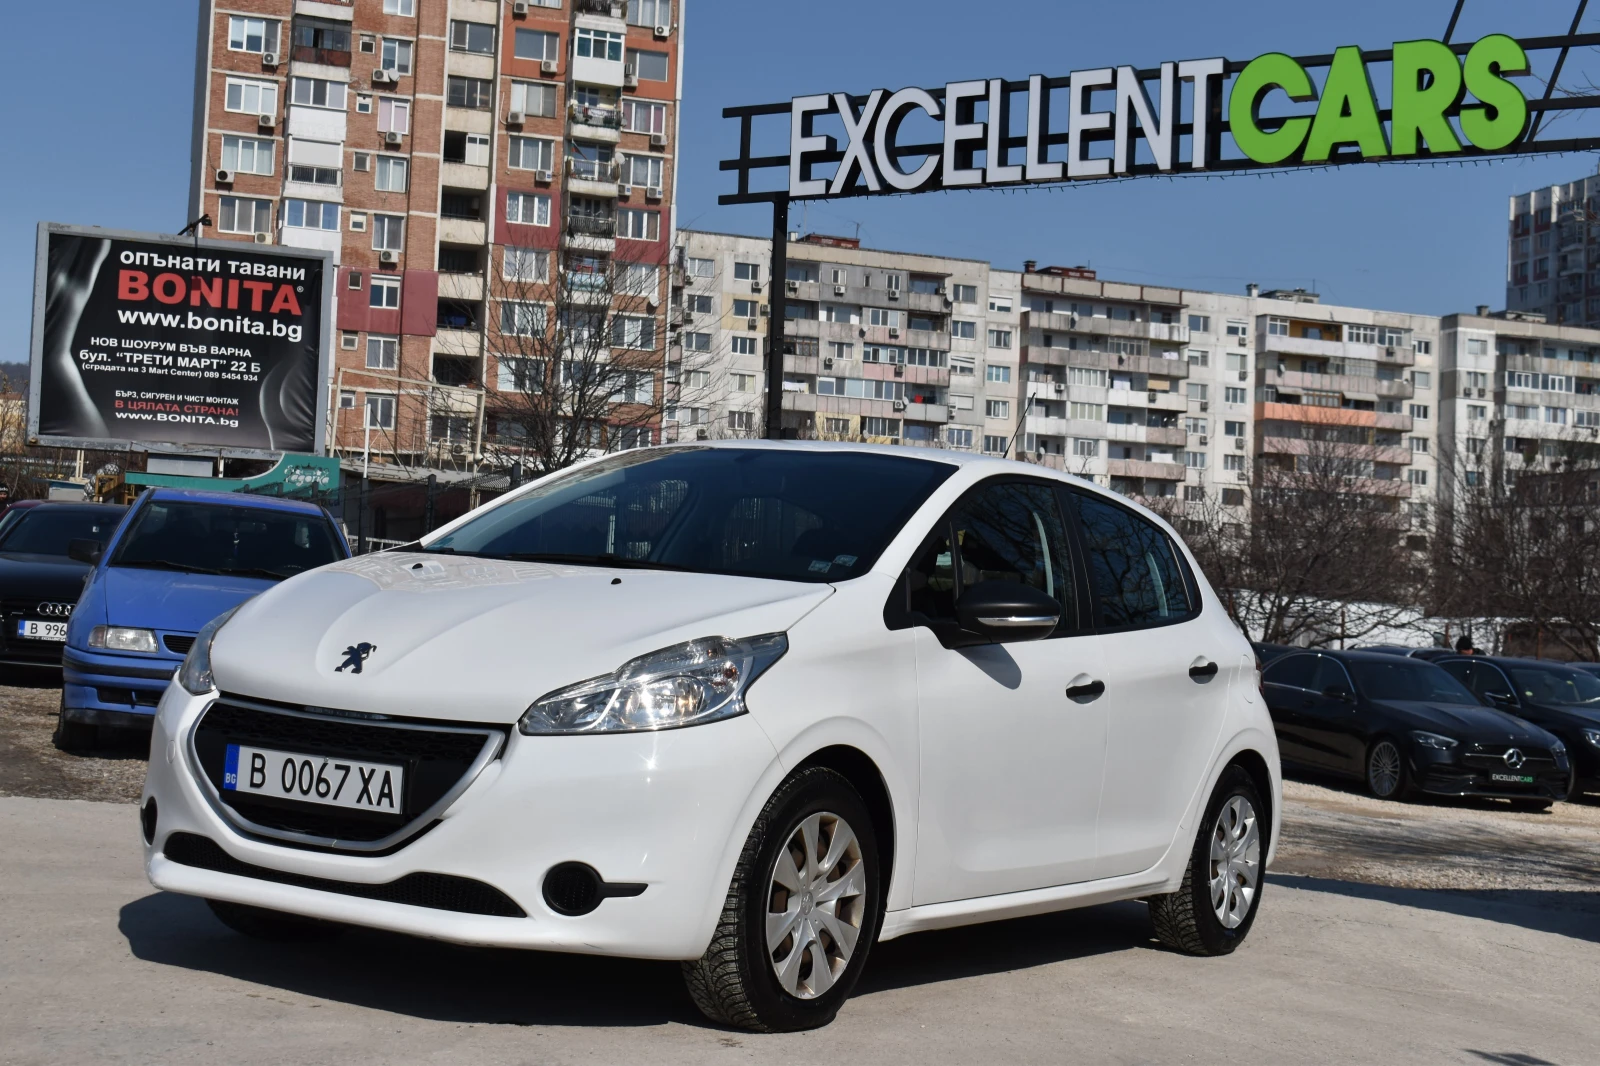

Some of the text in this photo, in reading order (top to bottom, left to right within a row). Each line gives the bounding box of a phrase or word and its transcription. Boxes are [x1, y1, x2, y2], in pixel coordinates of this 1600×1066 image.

[120, 250, 306, 281] опънати тавани
[117, 309, 303, 342] www.bonita.bg
[91, 336, 252, 358] НОВ ШОУРУМ ВЪВ ВАРНА
[79, 349, 111, 363] бул.
[230, 360, 247, 372] 22
[250, 362, 261, 373] Б
[82, 362, 126, 372] (сградата
[148, 366, 169, 375] Mart
[170, 368, 202, 379] Center)
[204, 371, 220, 379] 089
[221, 372, 241, 380] 5454
[243, 374, 258, 382] 934
[115, 390, 139, 399] БЪРЗ,
[140, 391, 175, 401] СИГУРЕН
[184, 394, 204, 403] ЧИСТ
[205, 396, 239, 405] МОНТАЖ
[114, 400, 239, 416] В ЦЯЛАТА СТРАНА!
[115, 412, 239, 428] www.BONITA.bg
[30, 622, 38, 635] B
[225, 772, 236, 784] BG
[249, 752, 395, 809] B 0067 XA
